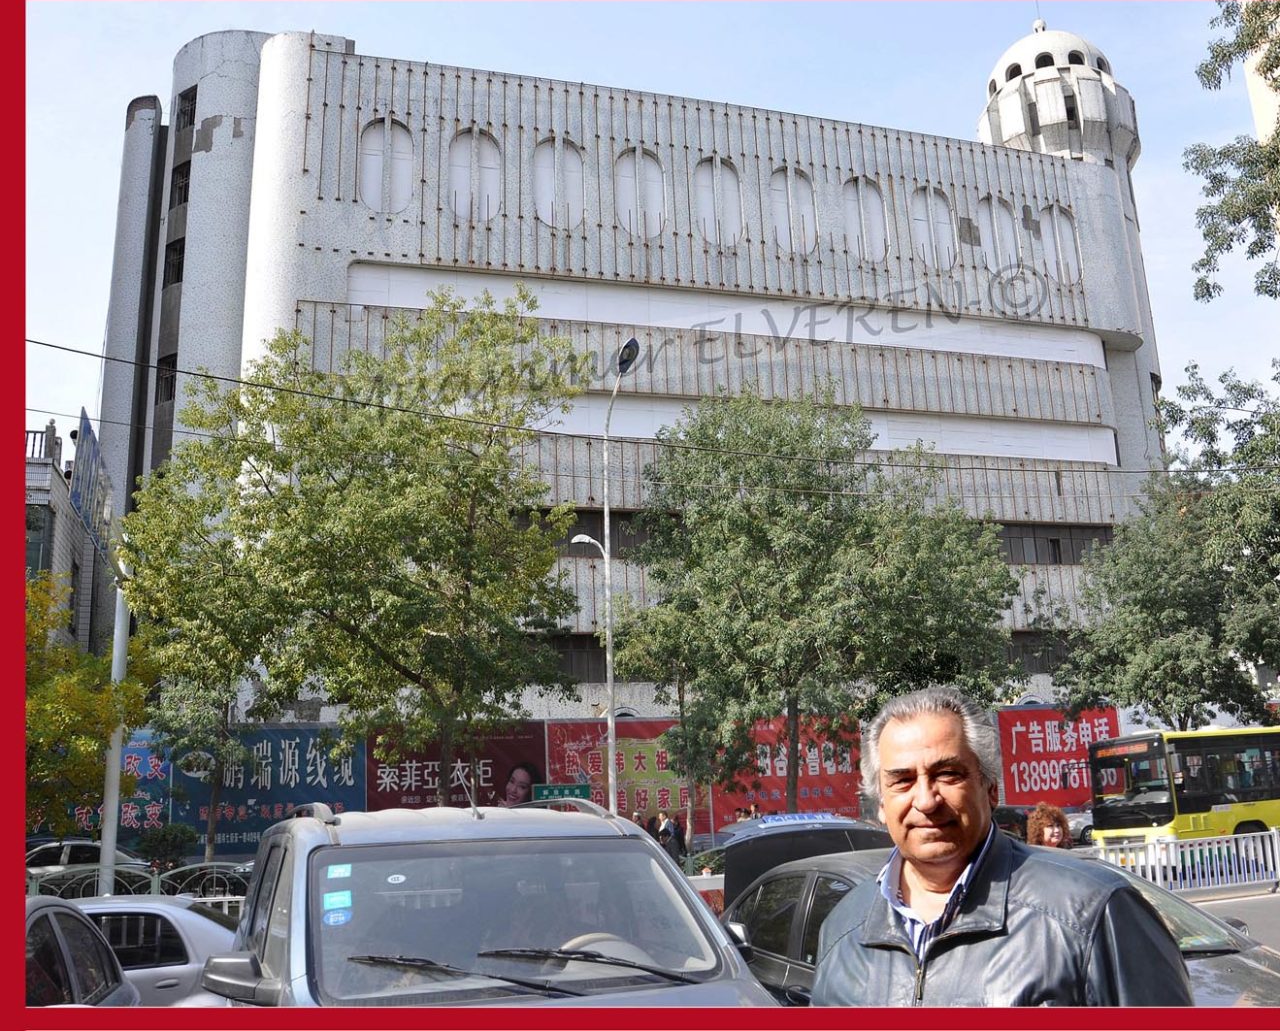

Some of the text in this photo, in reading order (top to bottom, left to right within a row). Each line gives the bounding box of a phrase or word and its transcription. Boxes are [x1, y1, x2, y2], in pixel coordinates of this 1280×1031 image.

[1011, 717, 1110, 756] 广告服务电话
